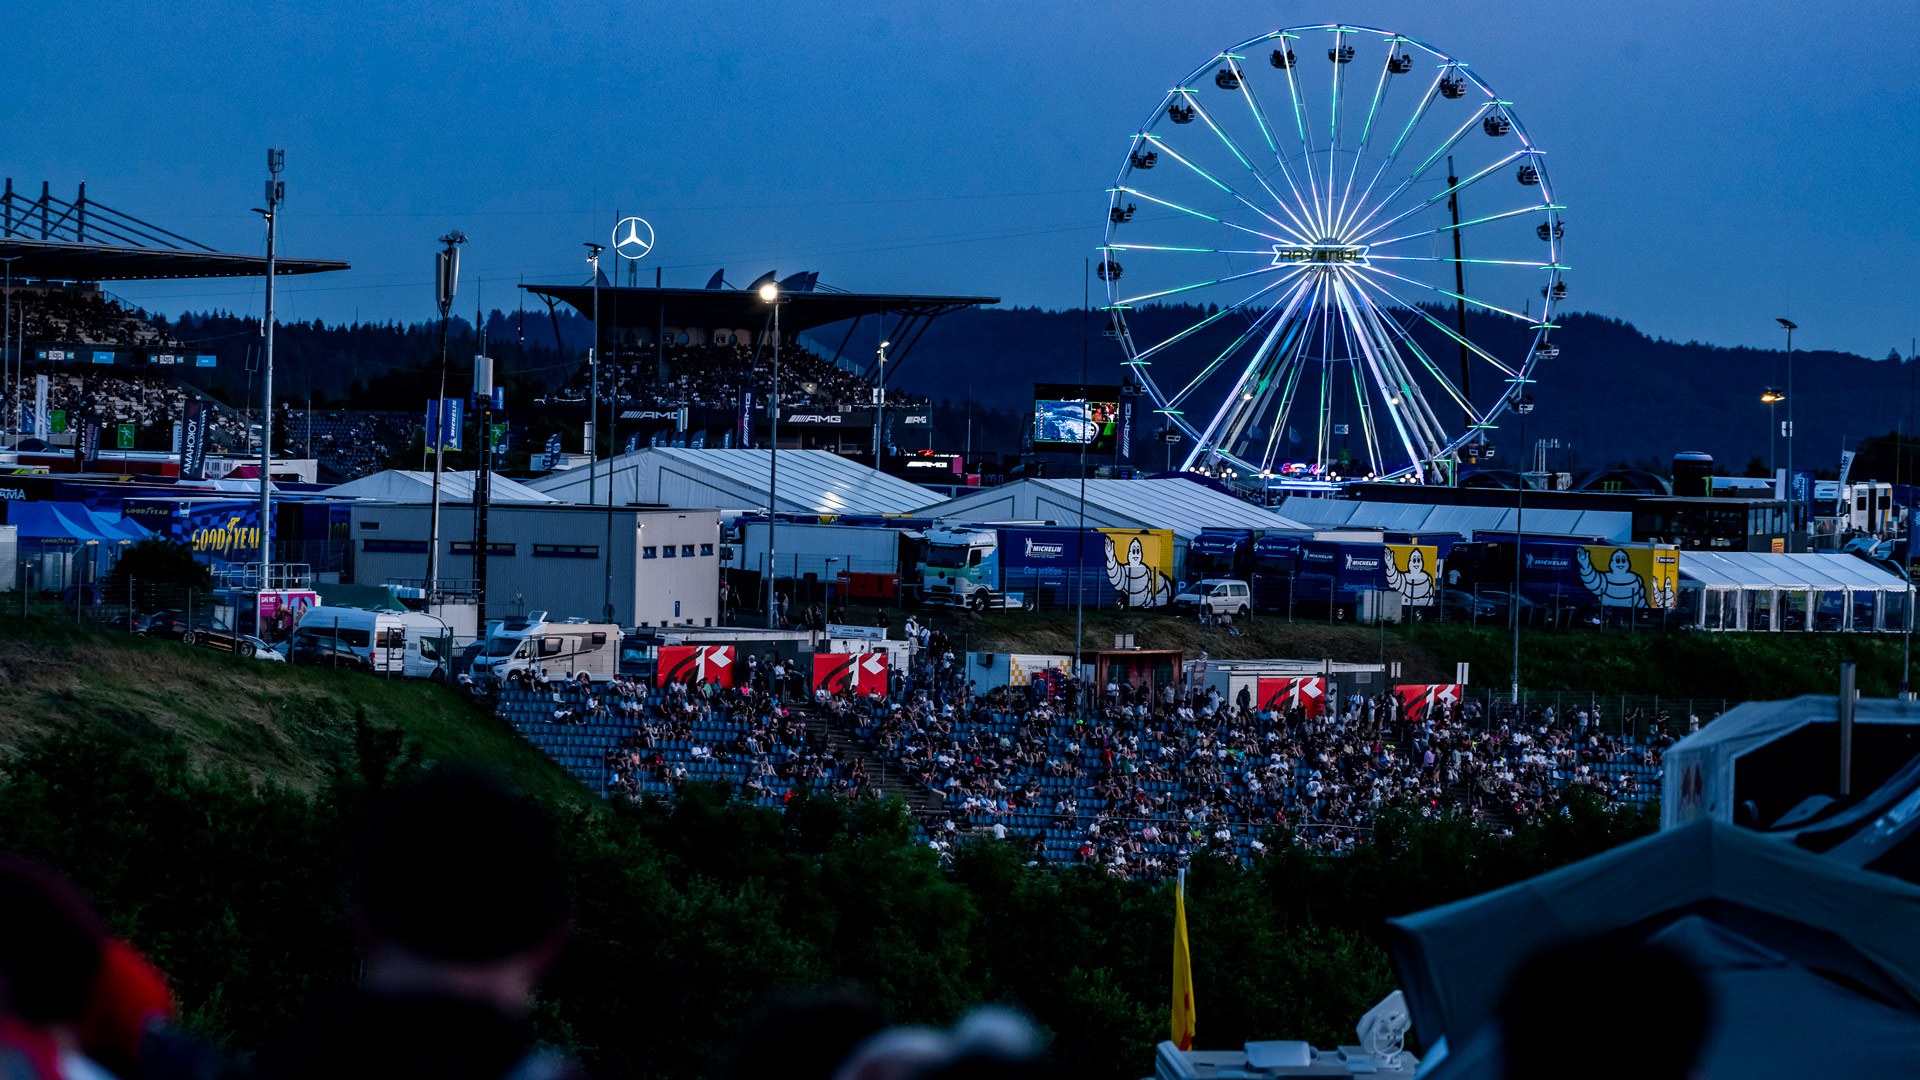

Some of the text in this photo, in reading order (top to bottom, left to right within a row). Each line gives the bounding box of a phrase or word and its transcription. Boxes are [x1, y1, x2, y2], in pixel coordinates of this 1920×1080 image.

[1280, 250, 1363, 260] RAVENOL
[805, 414, 842, 423] AMG
[911, 416, 927, 424] AMG
[1124, 403, 1132, 440] AMG
[125, 507, 169, 515] GOODYEAR
[192, 522, 260, 553] GOODYEA
[1534, 559, 1569, 567] MICHELIN
[1178, 581, 1187, 592] P
